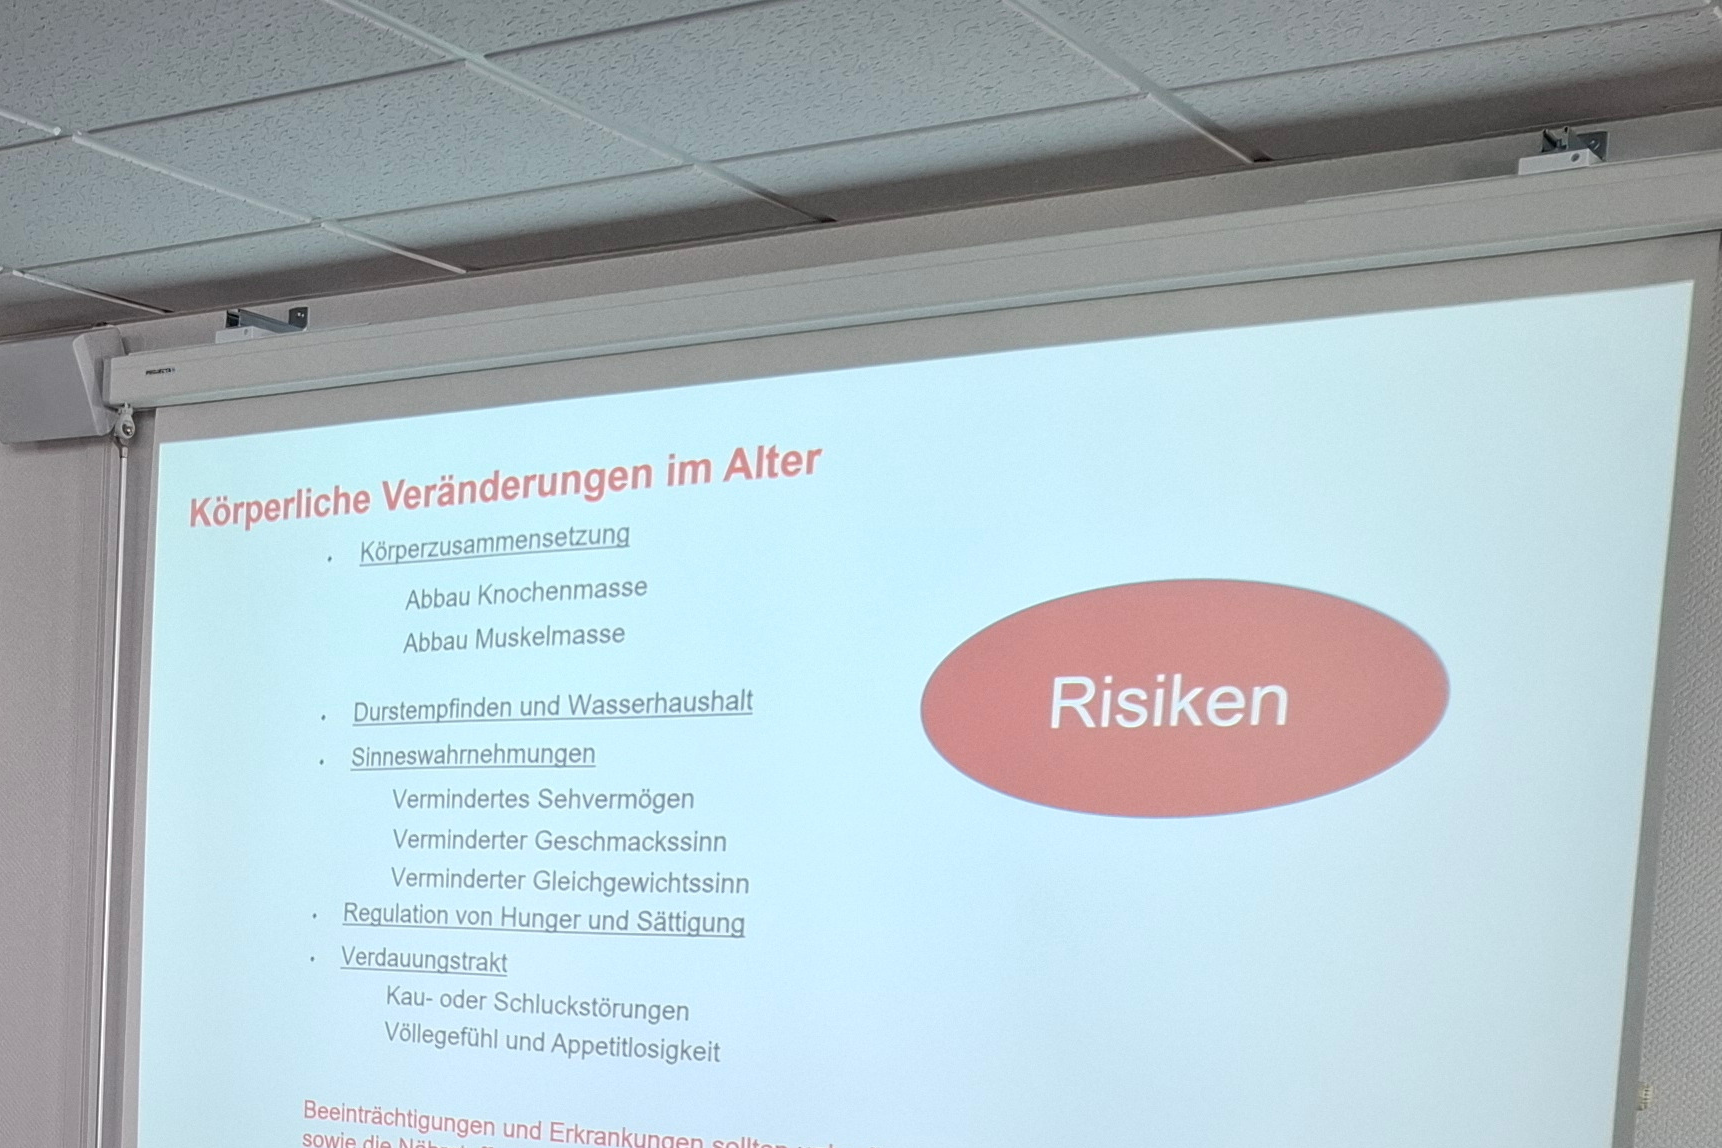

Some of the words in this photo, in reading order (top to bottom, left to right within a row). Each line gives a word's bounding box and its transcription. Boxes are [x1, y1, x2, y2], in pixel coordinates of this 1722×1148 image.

[189, 484, 371, 530] Körperliche
[382, 462, 654, 512] Veränderungen
[666, 454, 712, 486] im
[722, 444, 824, 482] Alter
[360, 524, 630, 565] Körperzusammensetzung
[405, 586, 471, 611] Abbau
[478, 578, 649, 606] Knochenmasse
[403, 629, 470, 654] Abbau
[476, 625, 626, 651] Muskelmasse
[353, 696, 513, 726] Durstempfinden
[519, 694, 560, 719] und
[567, 689, 754, 717] Wasserhaushalt
[1050, 673, 1289, 729] Risiken
[351, 743, 596, 770] Sinneswahrnehmungen
[392, 788, 531, 811] Vermindertes
[537, 788, 695, 815] Sehvermögen
[393, 829, 528, 851] Verminderter
[534, 829, 727, 853] Geschmackssinn
[391, 868, 526, 891] Verminderter
[532, 869, 750, 898] Gleichgewichtssinn
[343, 902, 449, 929] Regulation
[455, 908, 494, 927] von
[501, 906, 581, 933] Hunger
[588, 909, 630, 932] und
[636, 910, 746, 938] Sättigung
[341, 947, 508, 976] Verdauungstrakt
[386, 985, 433, 1006] Kau-
[439, 988, 488, 1010] oder
[493, 991, 690, 1025] Schluckstörungen
[385, 1021, 499, 1050] Völlegefühl
[505, 1030, 545, 1052] und
[551, 1033, 721, 1065] Appetitlosigkeit
[303, 1099, 496, 1137] Beeinträchtigungen
[502, 1117, 542, 1141] und
